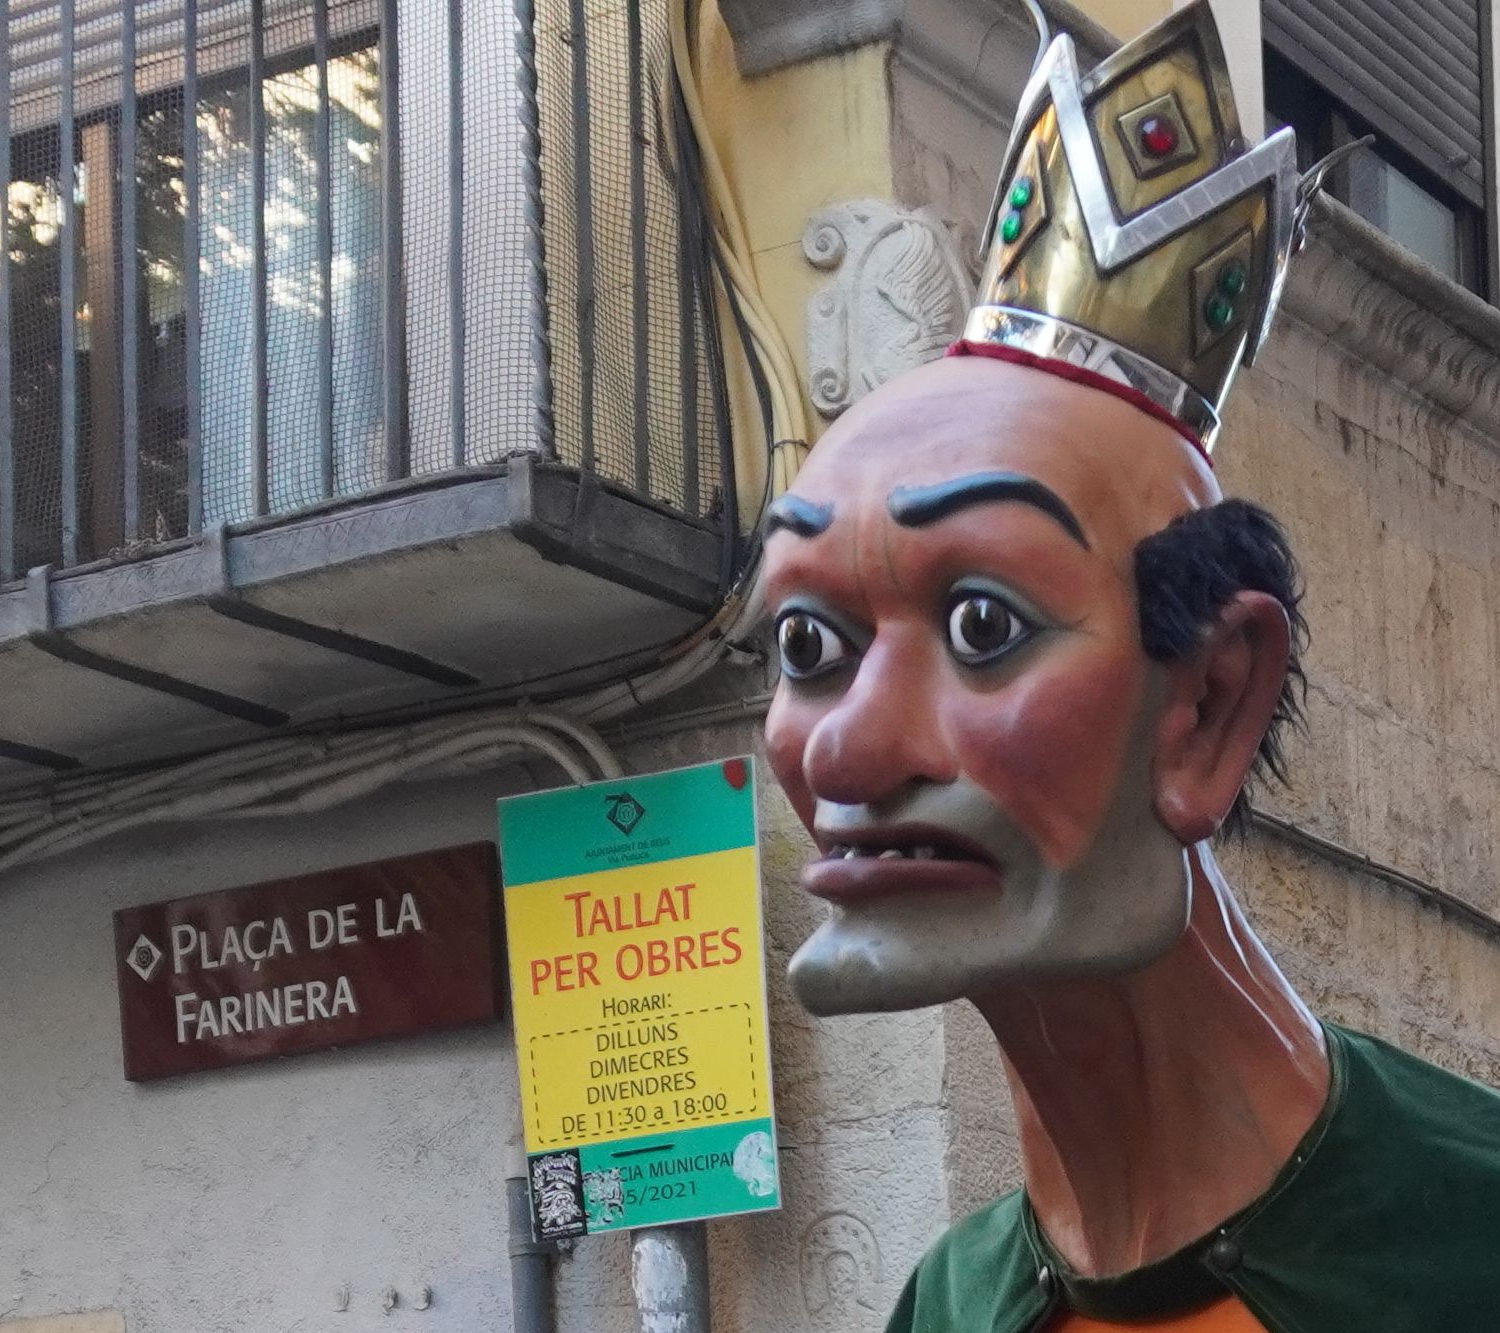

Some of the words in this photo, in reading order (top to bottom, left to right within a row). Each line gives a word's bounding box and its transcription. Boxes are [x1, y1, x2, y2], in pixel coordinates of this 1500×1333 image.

[564, 883, 696, 938] TALLAT
[171, 917, 293, 974] PLAÇA
[307, 903, 359, 950] DE
[375, 893, 422, 938] LA
[530, 951, 601, 996] PER
[615, 927, 742, 981] OBRES
[174, 976, 357, 1043] FARINERA
[602, 993, 672, 1018] HORARI:
[596, 1022, 678, 1052] DILLUNS
[590, 1047, 689, 1079] DIMECRES
[587, 1071, 697, 1105] DIVENDRES
[562, 1113, 588, 1135] DE
[594, 1105, 647, 1130] 11:30
[653, 1106, 663, 1120] a
[673, 1093, 728, 1117] 18:00
